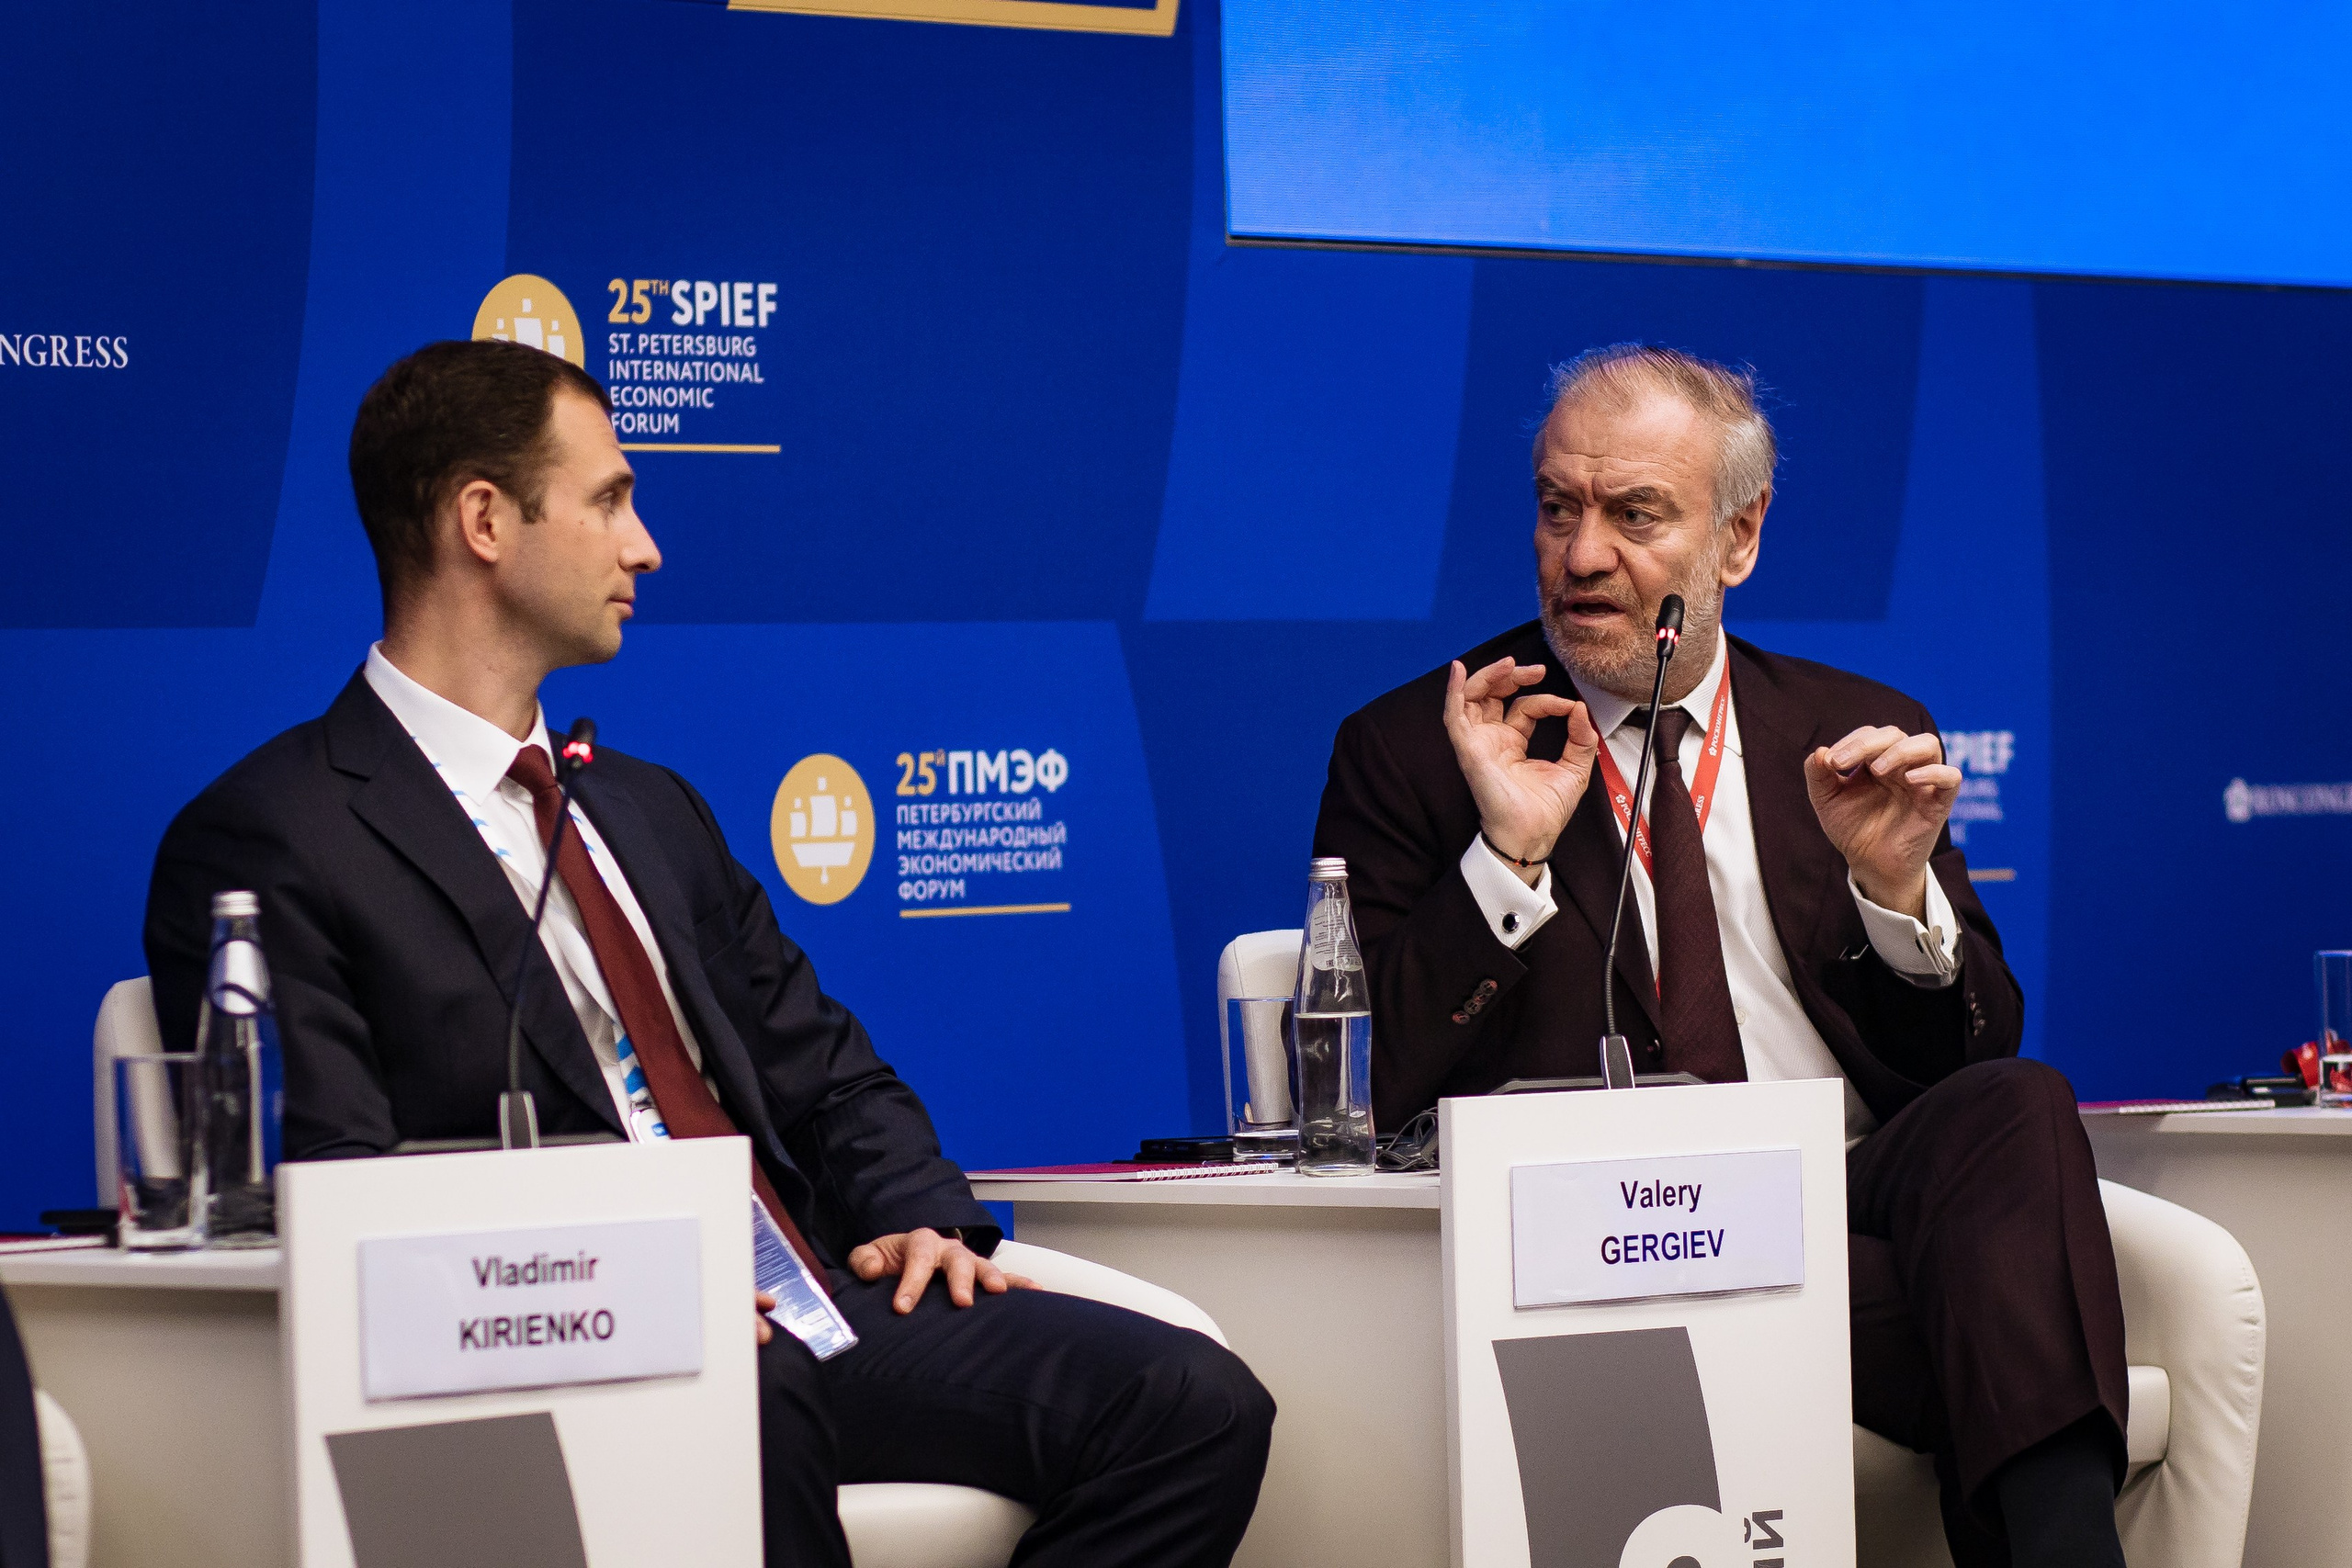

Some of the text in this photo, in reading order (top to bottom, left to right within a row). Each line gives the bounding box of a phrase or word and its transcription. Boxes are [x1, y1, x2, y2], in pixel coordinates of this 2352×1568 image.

[607, 278, 778, 328] 25TH SPIEF
[0, 333, 129, 368] NGRESS
[609, 333, 757, 357] ST. PETERSBURG
[609, 360, 764, 384] INTERNATIONAL
[610, 386, 715, 409] ECONOMIC
[611, 412, 680, 434] FORUM
[947, 748, 1069, 794] ПМЭФ
[897, 796, 1042, 825] ПЕТЕРБУРГСКИЙ
[897, 821, 1068, 851] МЕЖДУНАРОДНЫЙ
[898, 847, 1063, 876] ЭКОНОМИЧЕСКИЙ
[898, 878, 966, 901] ФОРУМ
[1620, 1179, 1702, 1213] Valery
[1600, 1229, 1724, 1265] GERGIEV
[470, 1250, 599, 1289] Vladimir
[459, 1309, 616, 1350] KIRIENKO
